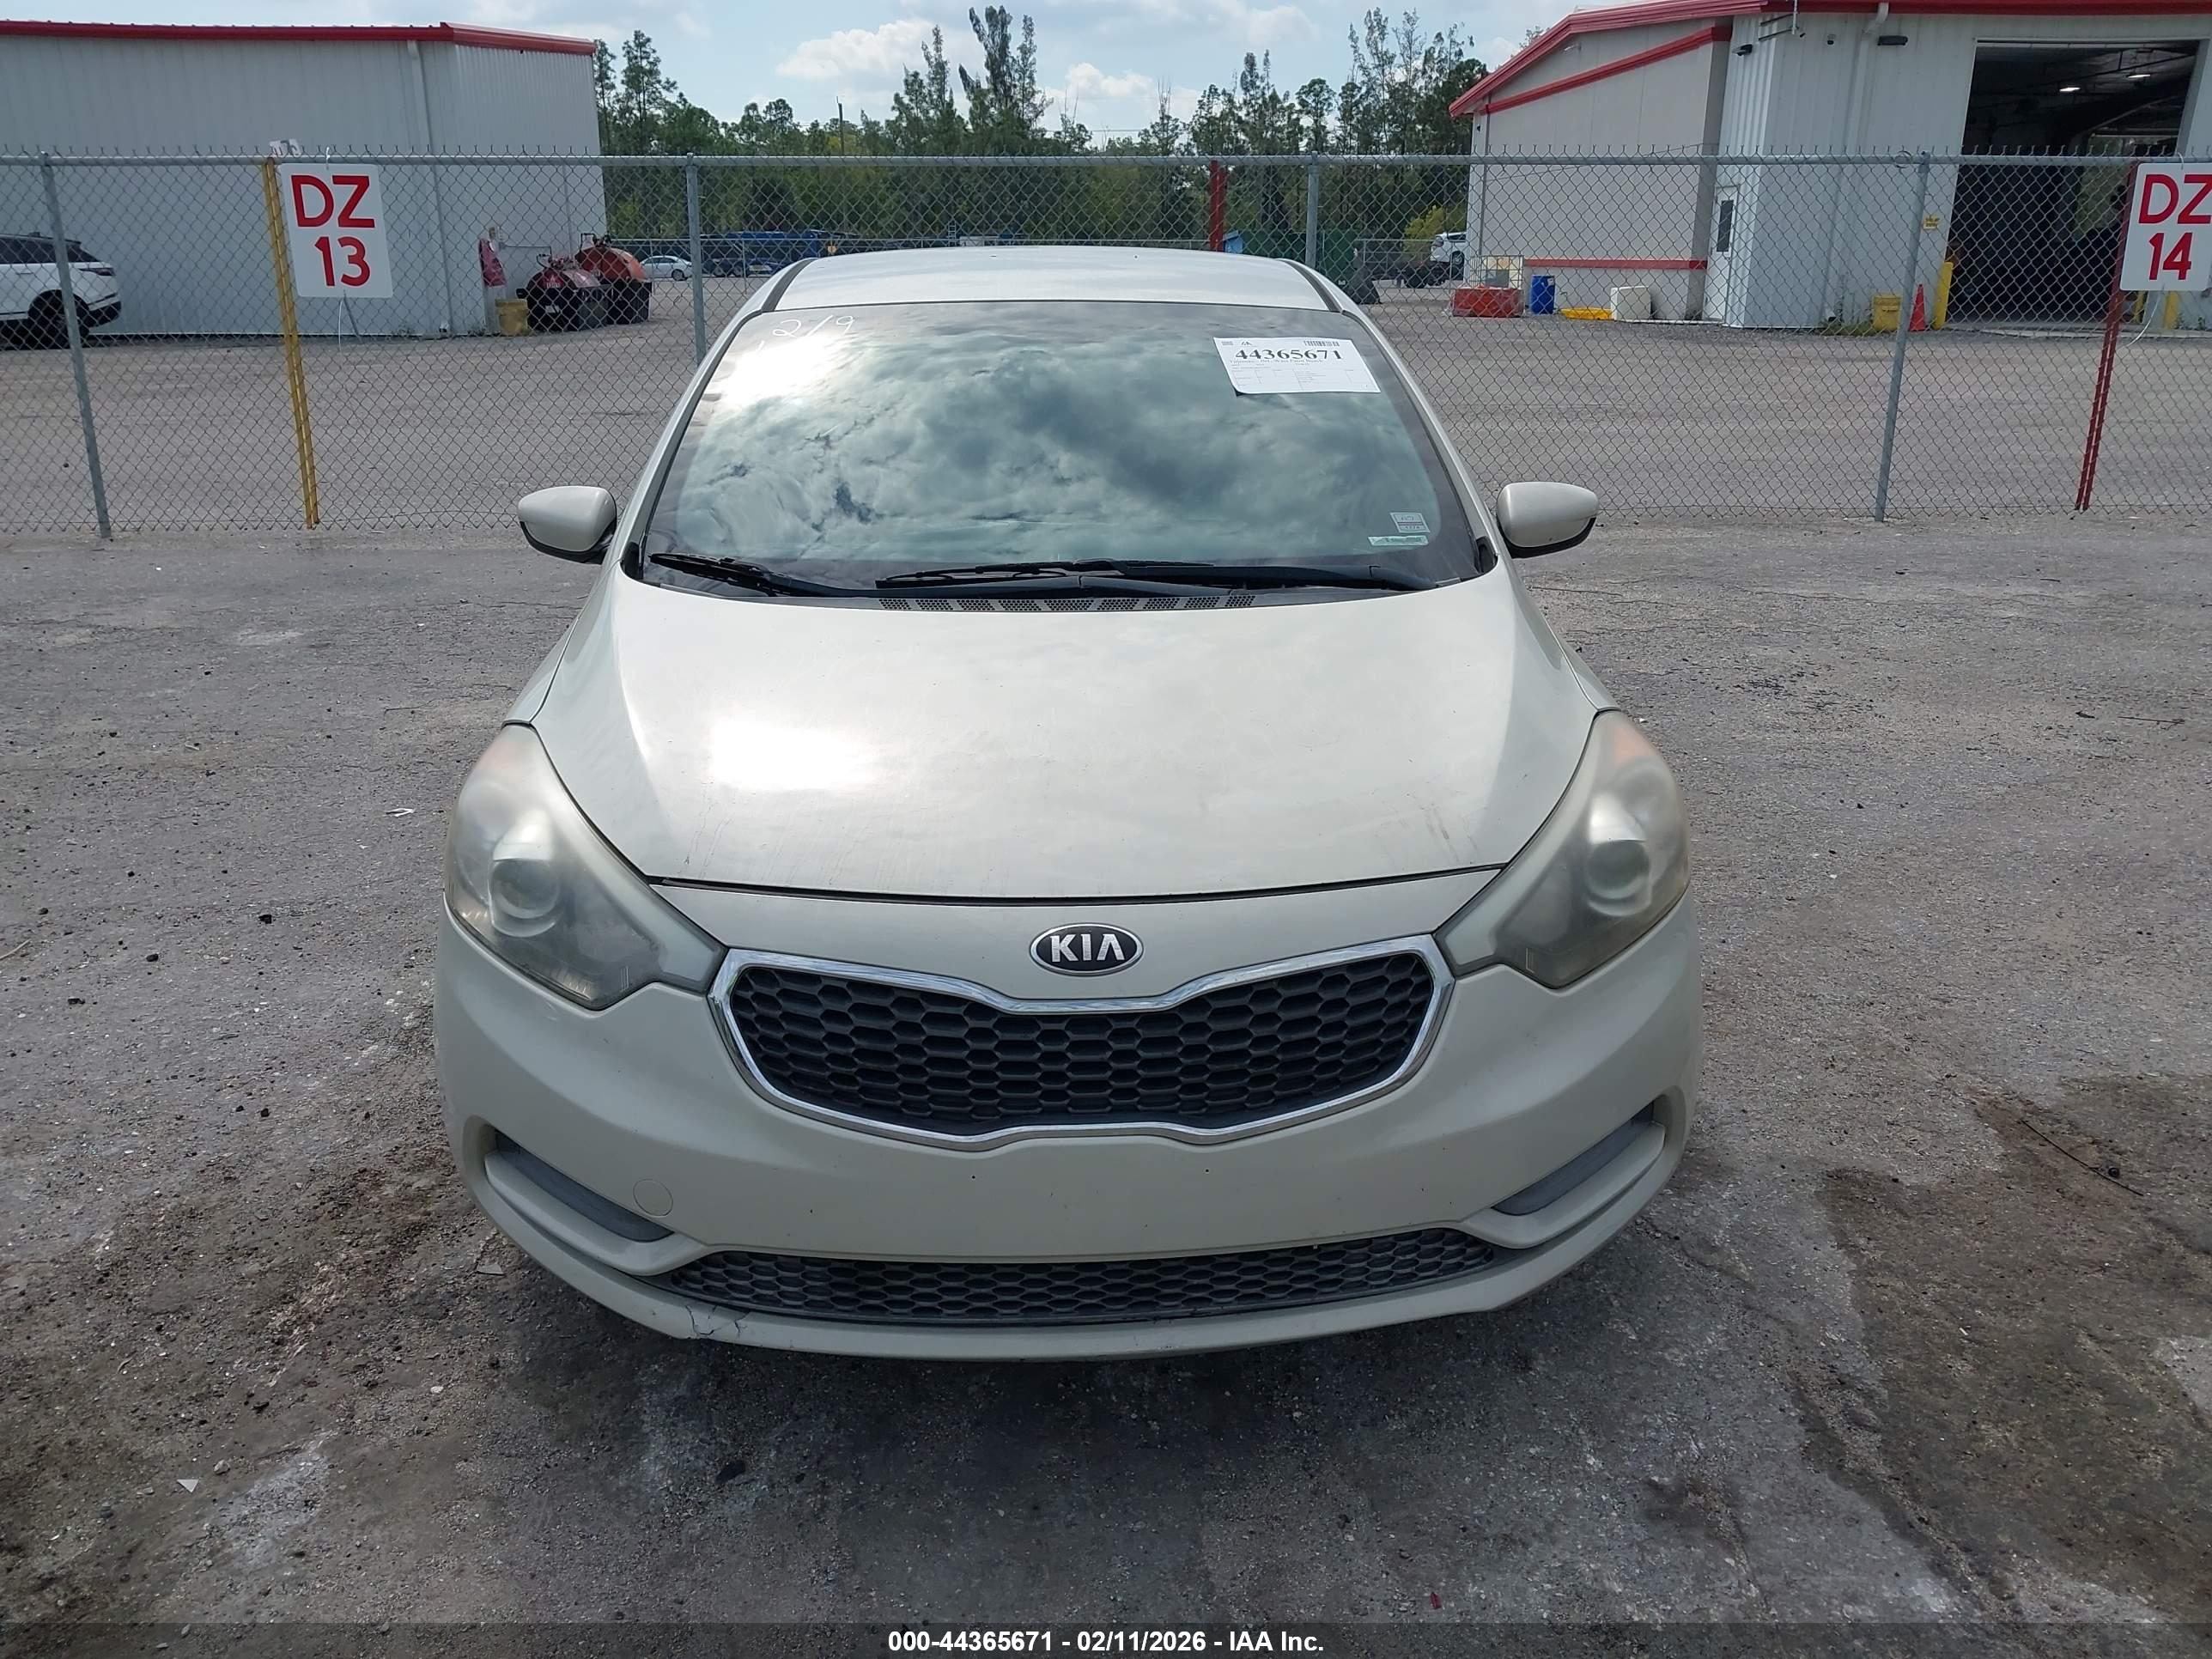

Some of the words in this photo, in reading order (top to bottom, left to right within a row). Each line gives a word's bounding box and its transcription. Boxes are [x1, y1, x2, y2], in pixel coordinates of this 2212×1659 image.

[291, 175, 375, 228] DZ
[2138, 174, 2212, 224] DZ
[314, 236, 370, 286] 13
[2148, 233, 2193, 280] 14
[773, 314, 854, 337] 2/9
[1235, 349, 1344, 360] 44365671
[1050, 933, 1125, 963] KIA
